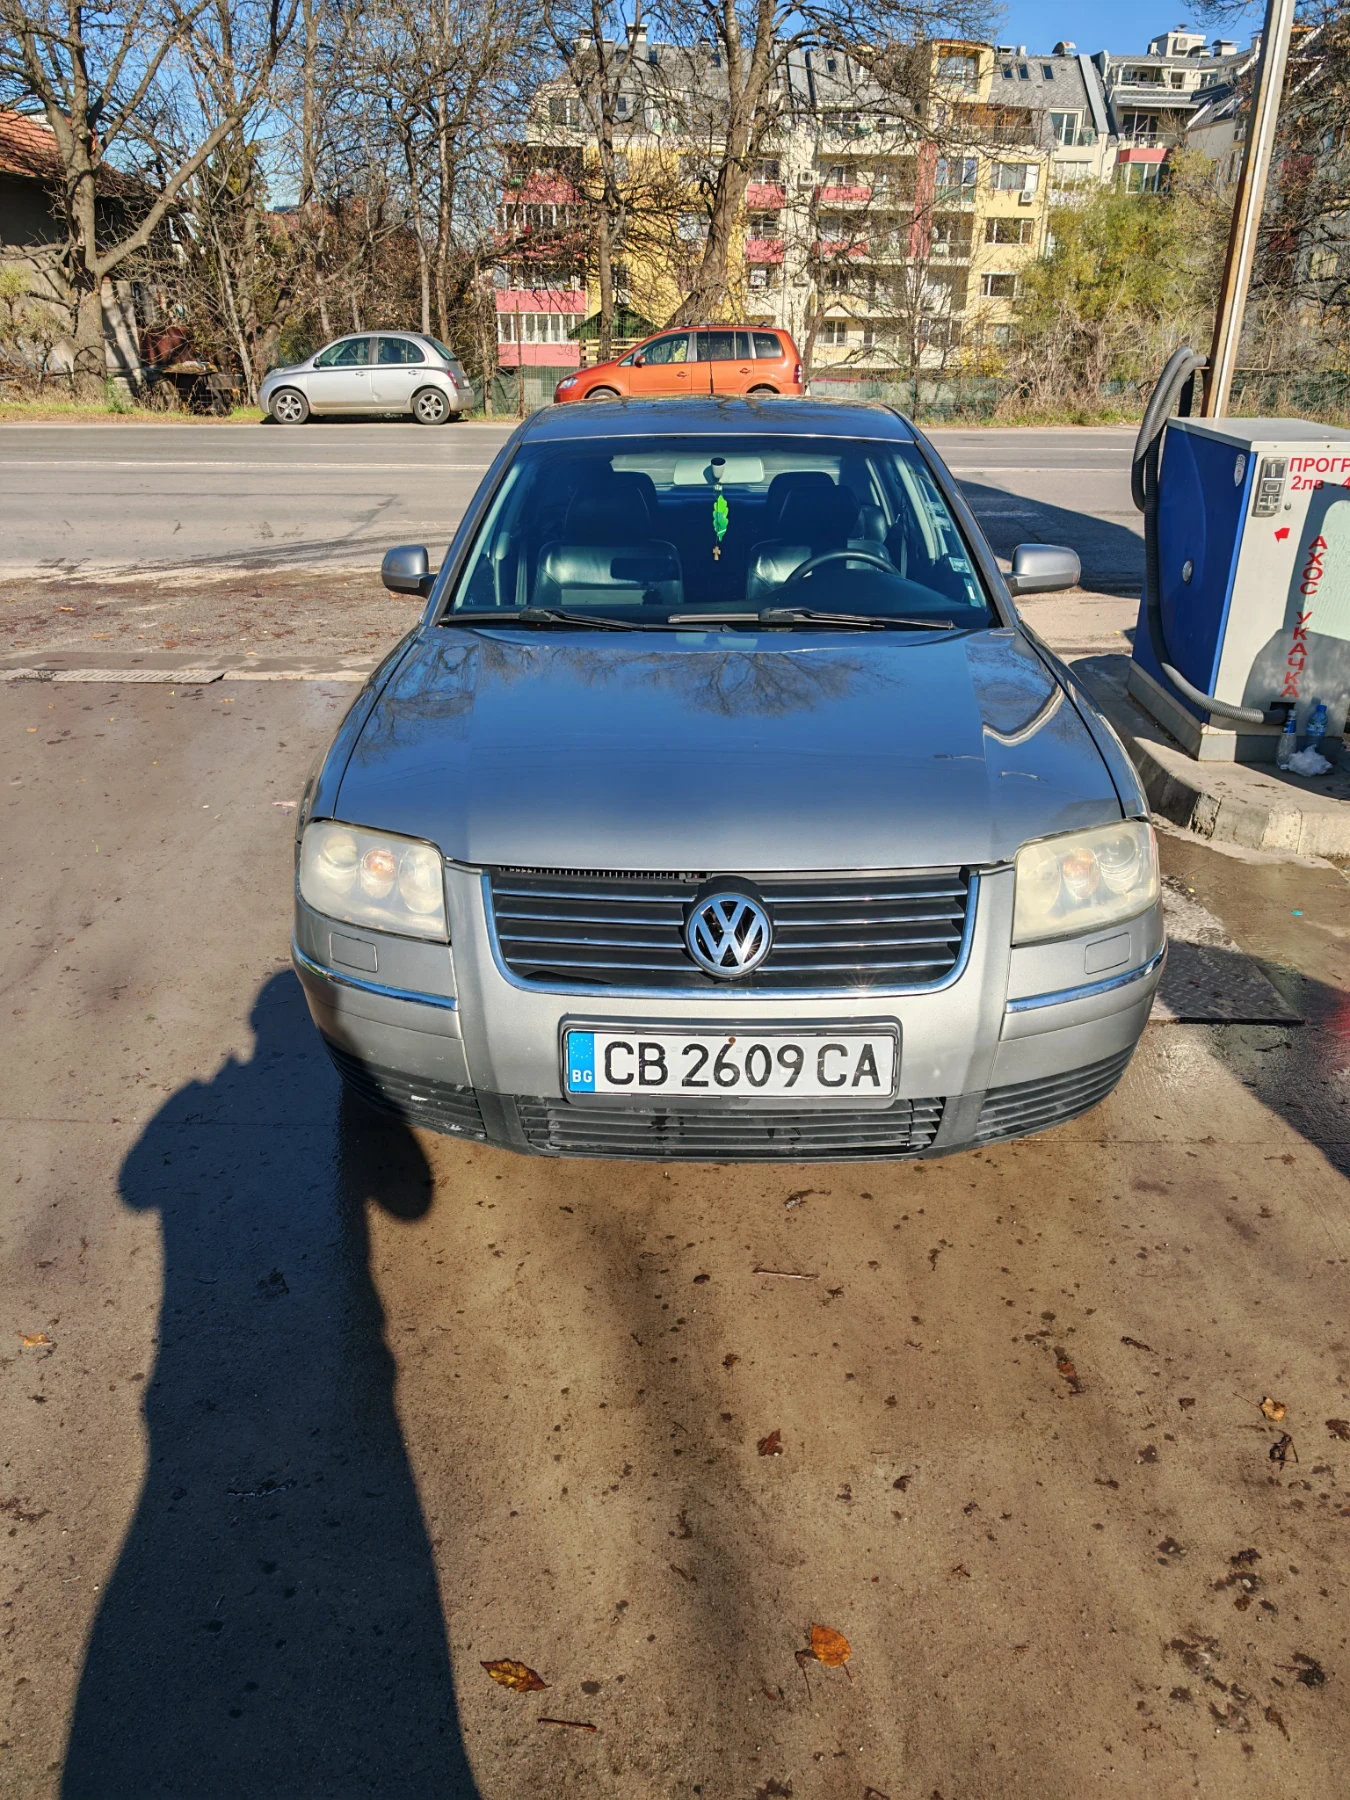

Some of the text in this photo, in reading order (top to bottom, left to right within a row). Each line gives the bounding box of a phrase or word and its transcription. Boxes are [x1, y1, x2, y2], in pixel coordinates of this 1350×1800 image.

[1289, 457, 1350, 473] ПРОГР
[1290, 475, 1325, 490] 2лв
[1280, 535, 1328, 697] АХОС УКАЧКА
[687, 893, 771, 976] VW
[572, 1069, 593, 1083] BG
[604, 1041, 881, 1088] CB 2609 CA
